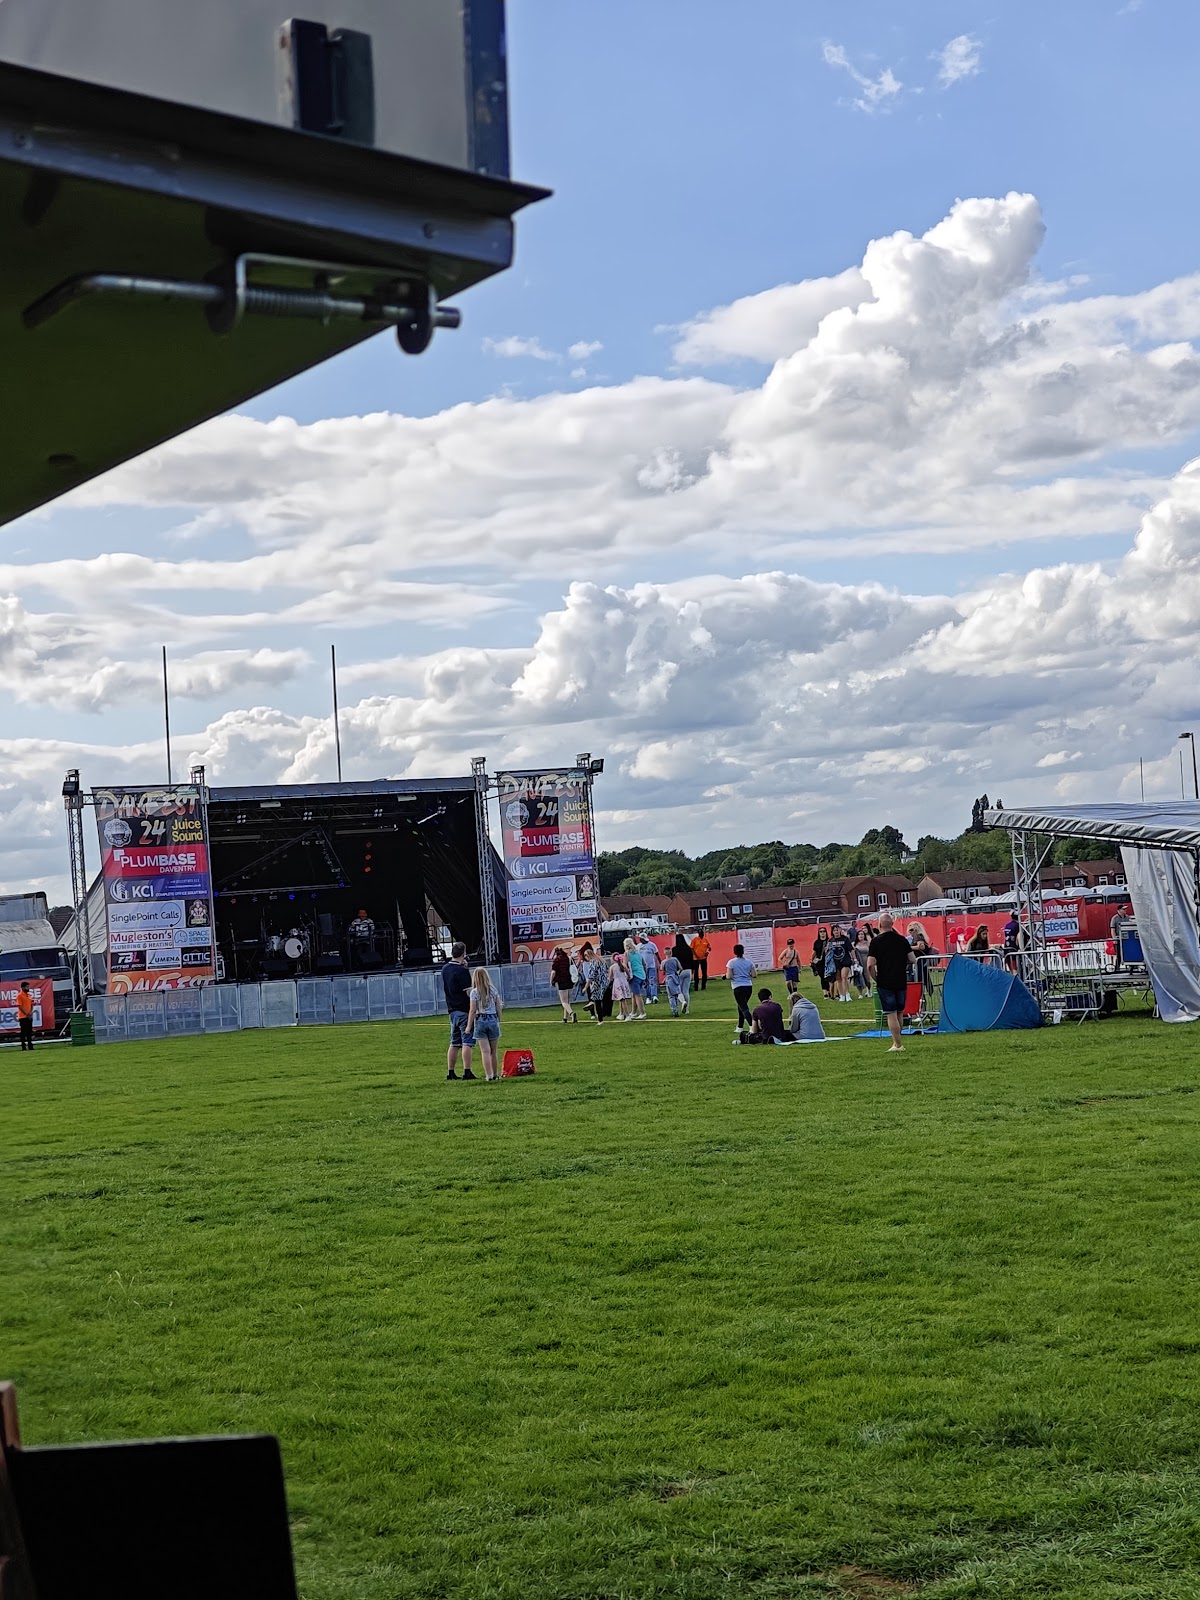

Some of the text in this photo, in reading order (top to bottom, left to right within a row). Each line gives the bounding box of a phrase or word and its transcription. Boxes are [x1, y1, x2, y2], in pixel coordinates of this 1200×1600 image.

[563, 801, 588, 811] Juice
[535, 801, 558, 825] 24
[563, 811, 589, 822] Sound
[172, 819, 202, 830] Juice
[139, 820, 166, 845] 24
[172, 830, 203, 842] Sound
[520, 832, 584, 847] PLUMBASE
[553, 843, 584, 851] DAVENTRY
[121, 853, 196, 867] PLUMBASE
[160, 865, 197, 873] DAVENTRY
[529, 862, 548, 874] KCI
[132, 885, 154, 898] KCI
[511, 885, 571, 898] SinglePoint Calls
[511, 904, 565, 916] Mugleston's
[111, 911, 180, 923] SinglePoint Calls
[545, 923, 572, 935] LUMENA
[110, 930, 172, 943] Mugleston's
[148, 951, 180, 964] LUMENA
